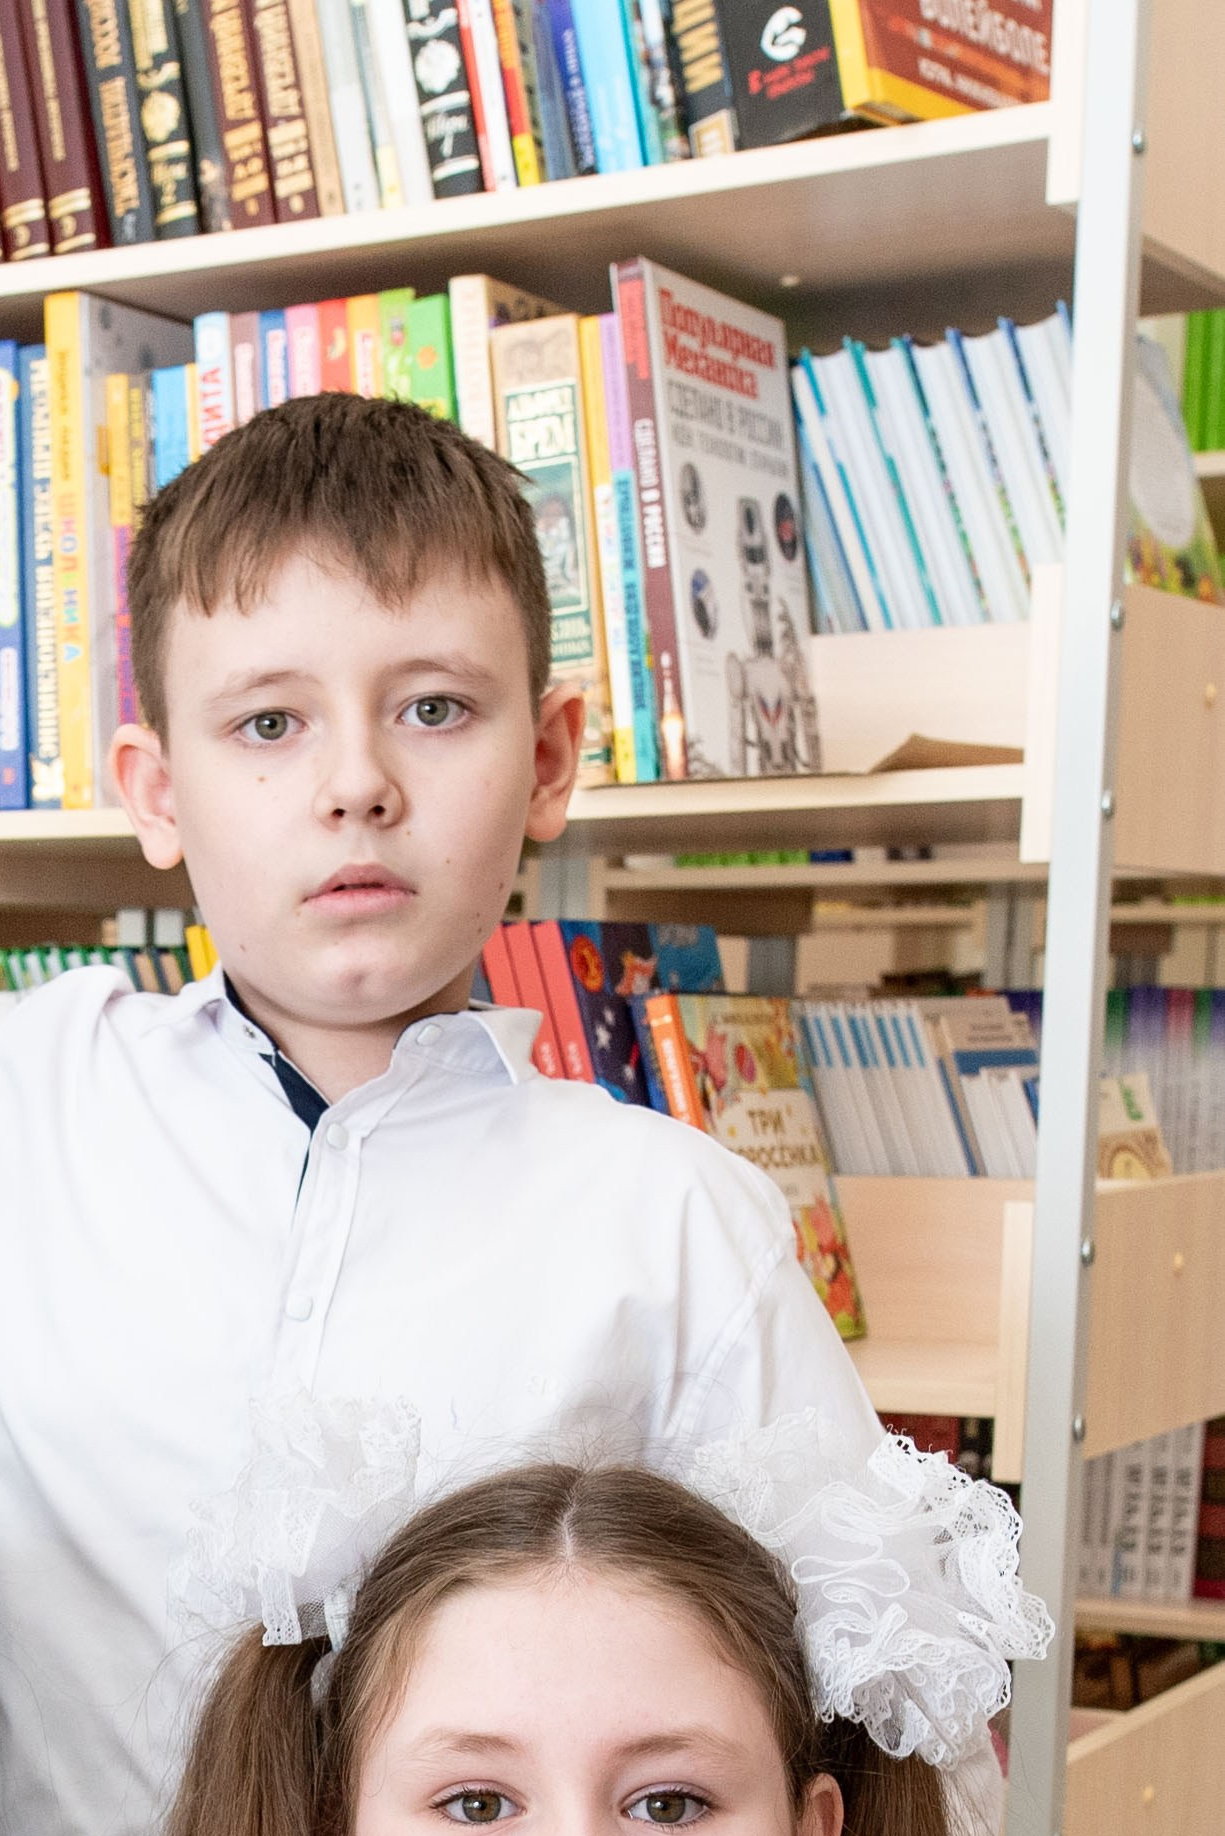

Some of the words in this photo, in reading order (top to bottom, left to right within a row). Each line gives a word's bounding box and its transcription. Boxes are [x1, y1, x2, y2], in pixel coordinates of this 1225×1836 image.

[658, 287, 777, 371] Популярная
[662, 329, 759, 400] Механика
[29, 358, 53, 479] ПРИРОДЫ
[643, 504, 667, 569] РОССИИ
[35, 565, 60, 758] ЭНЦИКЛОПЕДИЯ
[746, 1109, 786, 1136] ТРИ
